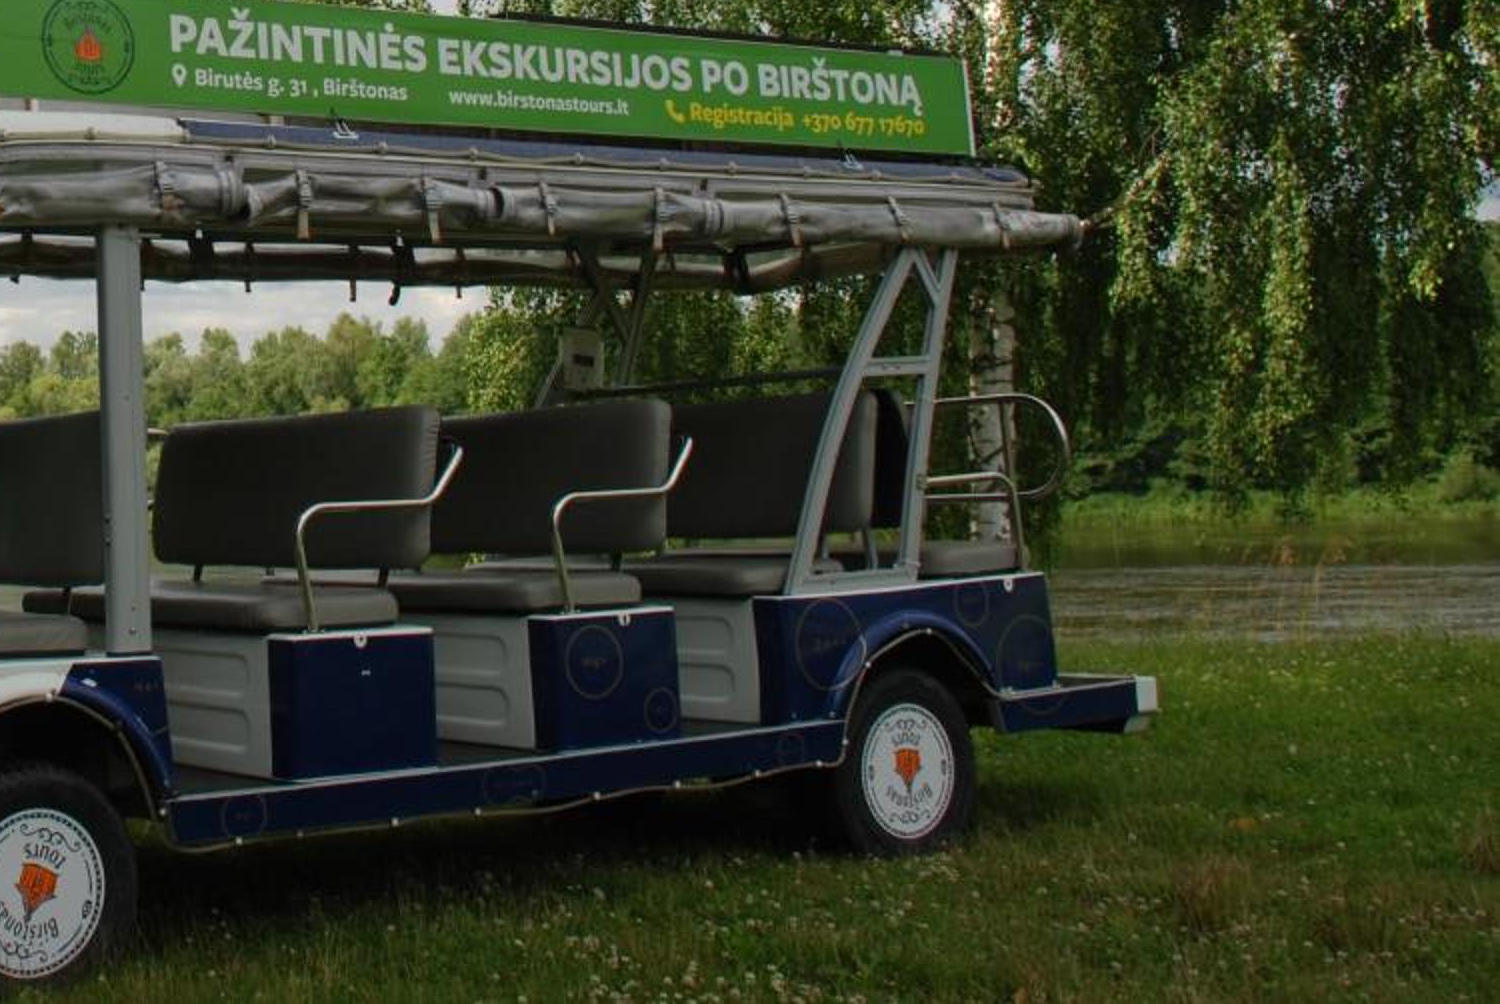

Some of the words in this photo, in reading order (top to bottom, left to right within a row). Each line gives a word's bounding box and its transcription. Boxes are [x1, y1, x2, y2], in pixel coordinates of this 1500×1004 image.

[169, 8, 427, 73] PAŽINTINĖS
[437, 38, 693, 92] EKSKURSIJOS
[701, 59, 749, 95] PO
[757, 57, 924, 117] BIRŠTONĄ
[195, 67, 263, 92] Birutės
[268, 77, 284, 97] g.
[290, 79, 307, 96] 31
[323, 77, 408, 101] Birštonas
[449, 90, 629, 116] www.birstonastours.lt
[690, 102, 794, 132] Registracija
[803, 113, 842, 133] +370
[845, 111, 875, 135] 677
